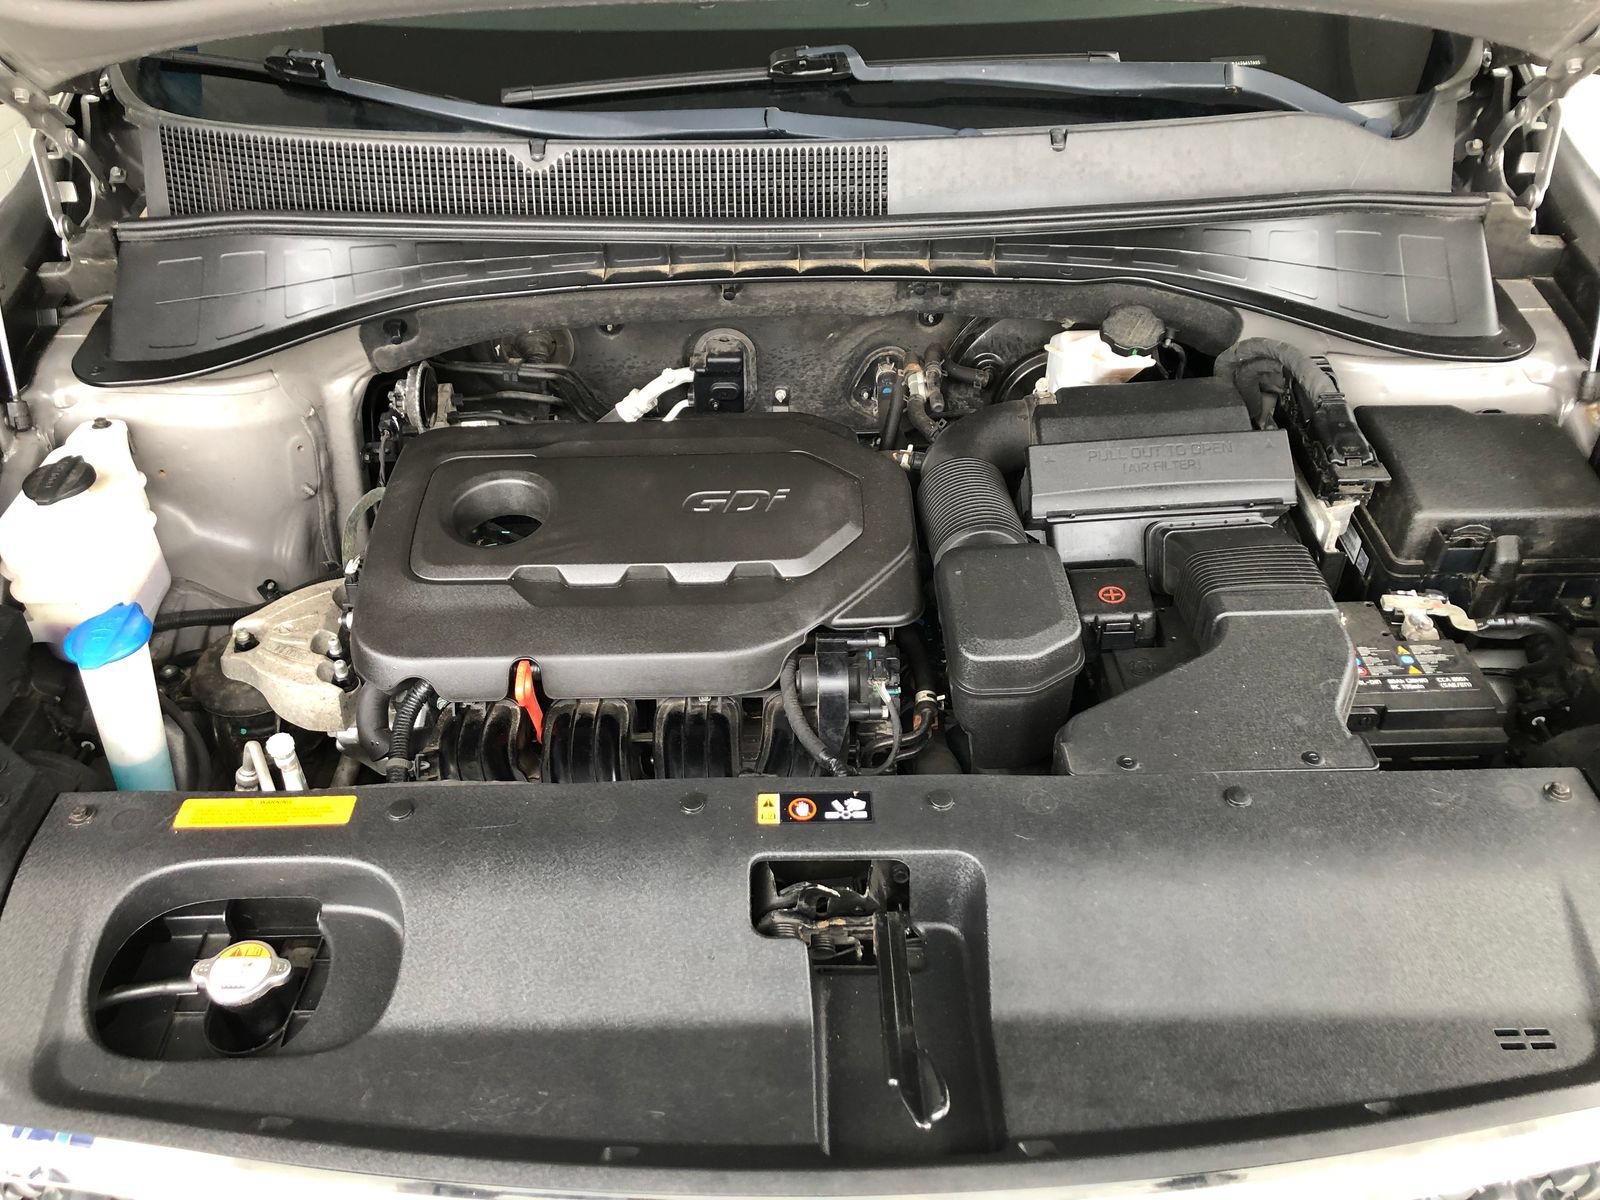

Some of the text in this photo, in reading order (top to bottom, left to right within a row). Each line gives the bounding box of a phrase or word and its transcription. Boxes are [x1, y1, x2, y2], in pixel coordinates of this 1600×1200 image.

[1087, 440, 1233, 462] PULL OUT TO OPEN
